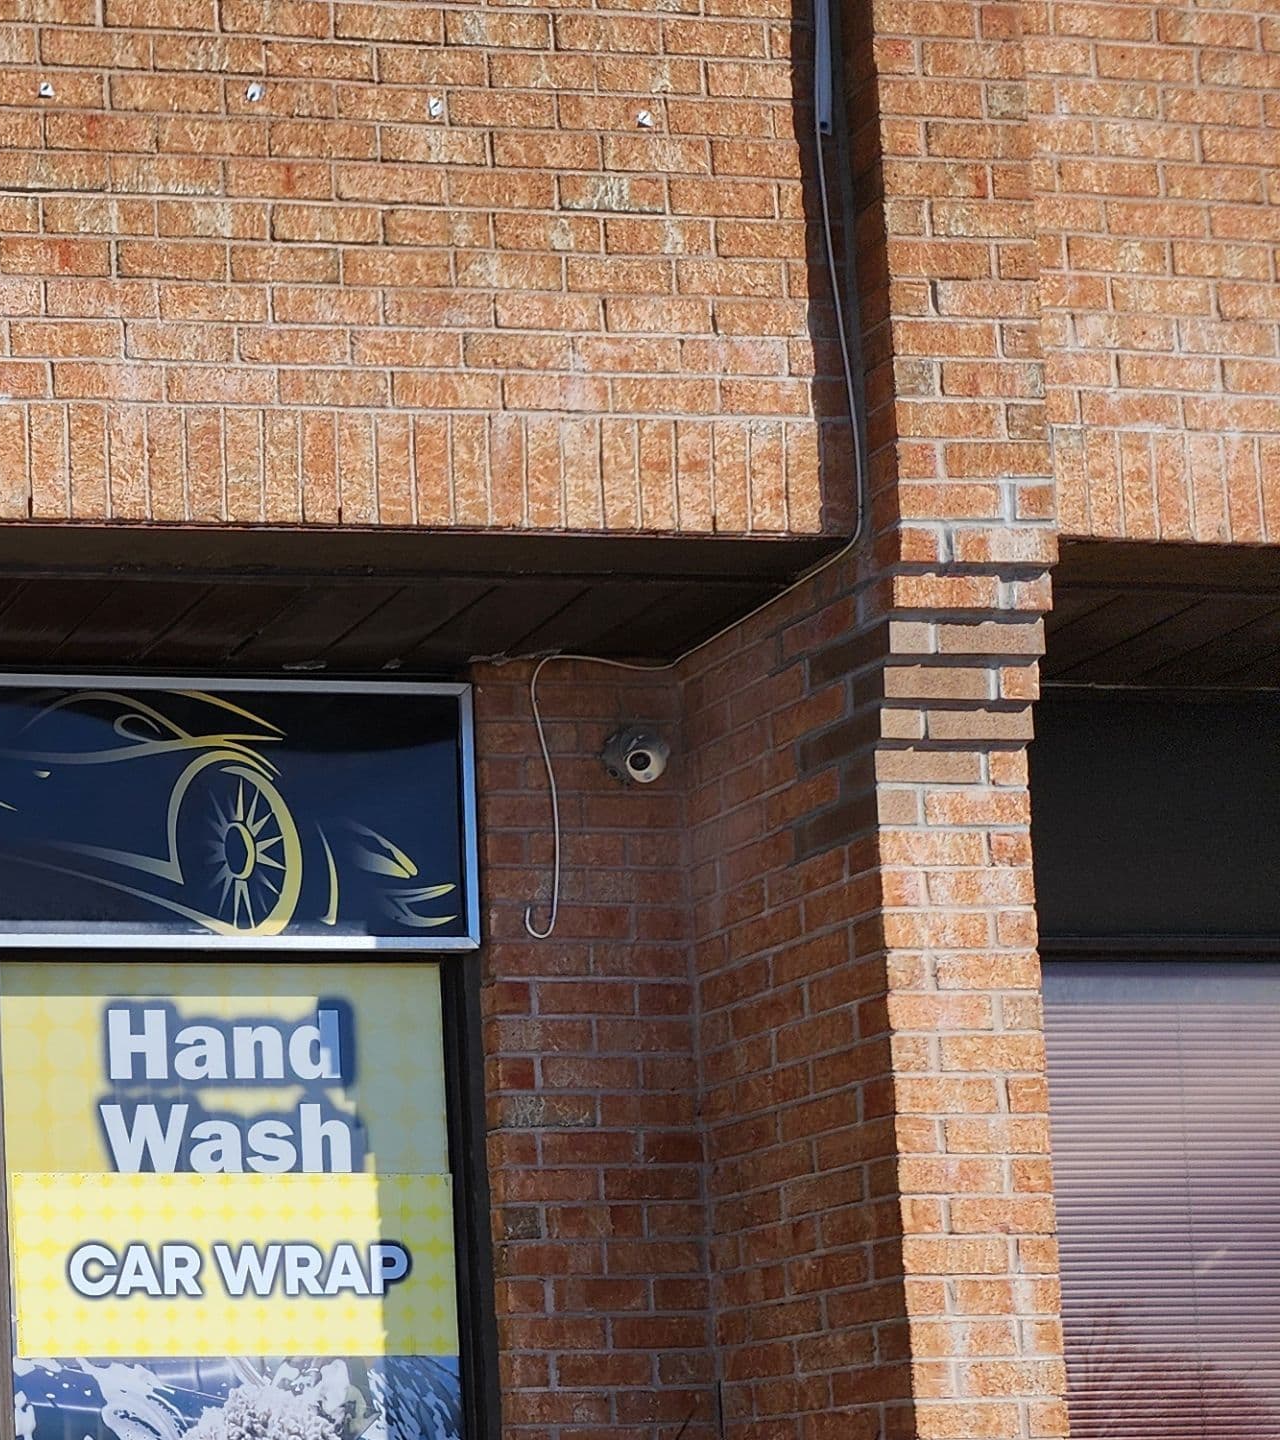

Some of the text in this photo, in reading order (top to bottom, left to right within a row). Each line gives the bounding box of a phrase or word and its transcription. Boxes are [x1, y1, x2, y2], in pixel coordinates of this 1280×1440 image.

[107, 1007, 342, 1081] Hand
[99, 1103, 352, 1173] Wash
[69, 1243, 410, 1297] CAR WRAP
